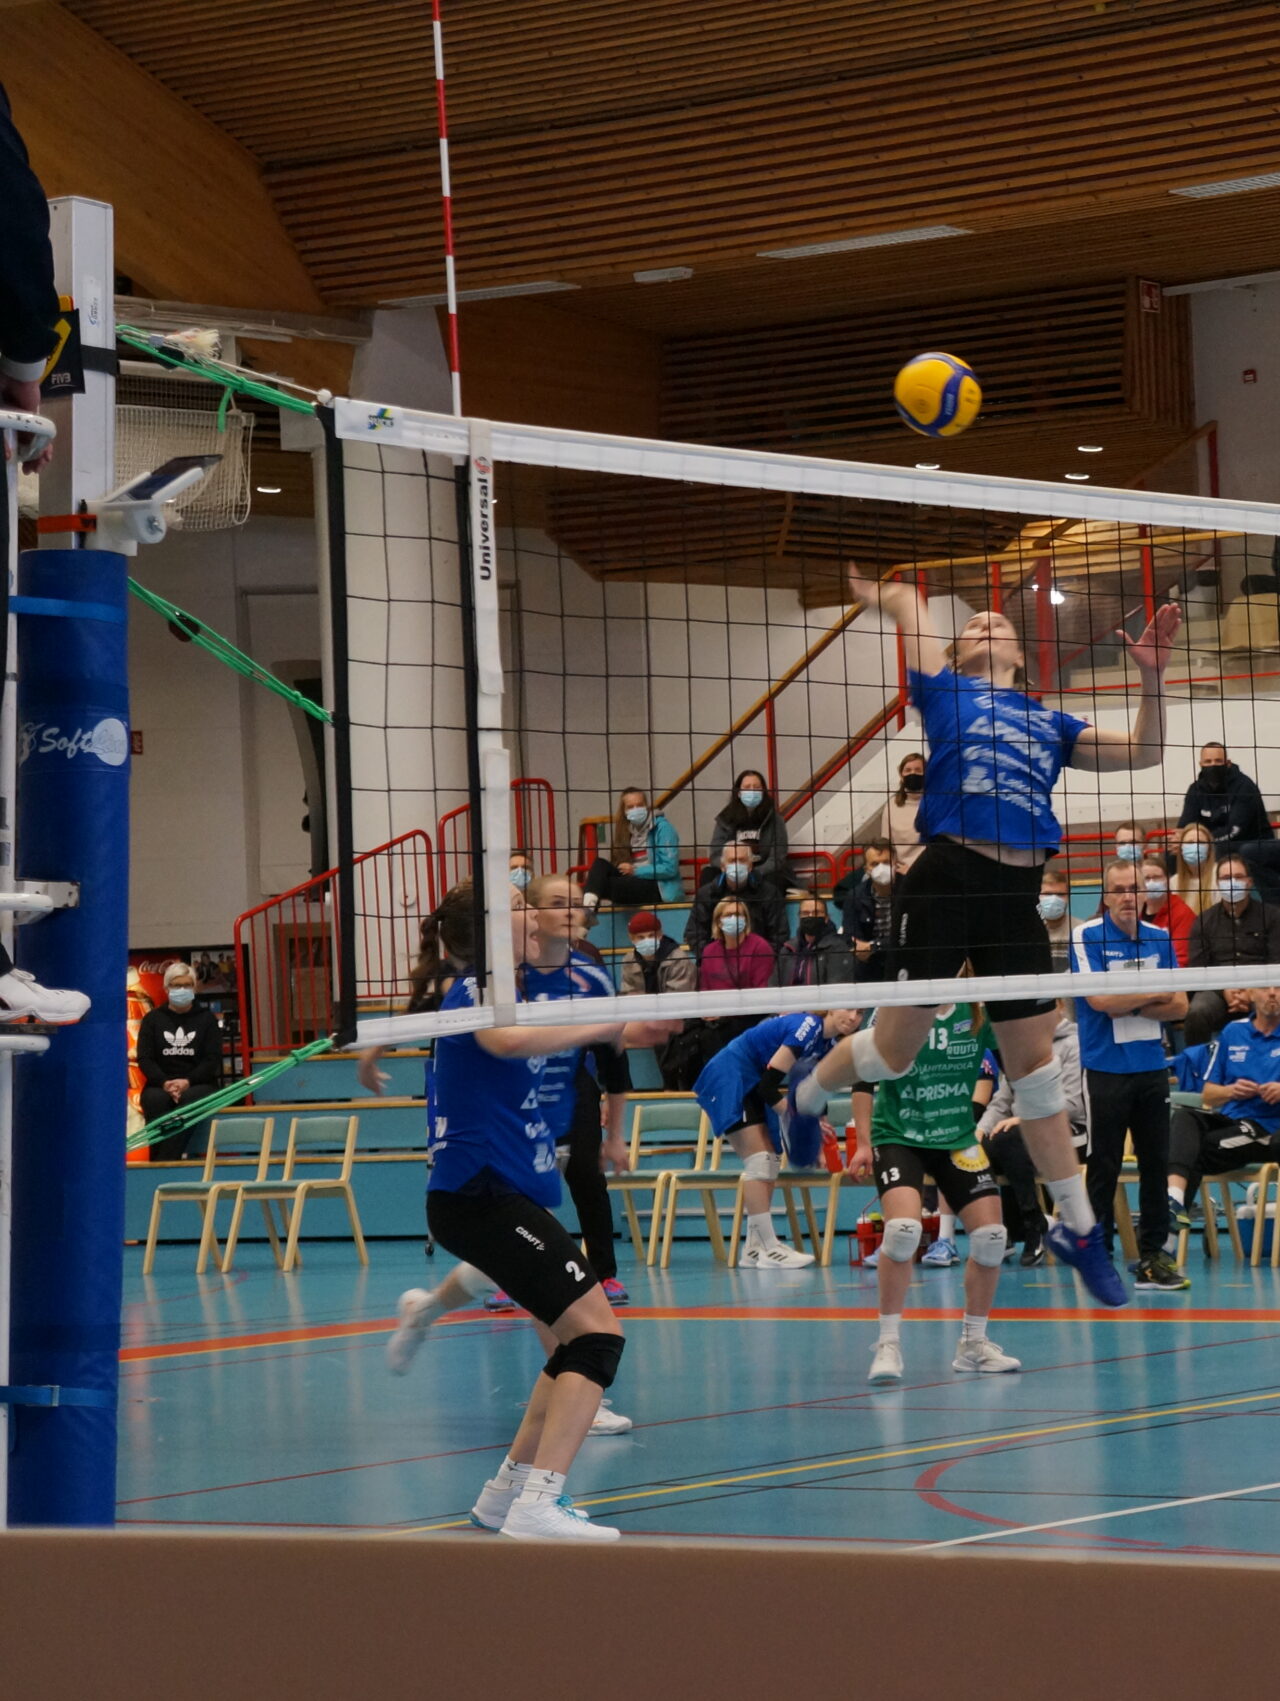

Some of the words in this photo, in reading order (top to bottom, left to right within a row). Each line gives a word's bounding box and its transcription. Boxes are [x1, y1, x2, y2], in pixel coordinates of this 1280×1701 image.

[477, 478, 492, 581] Universal
[928, 1027, 948, 1050] 13
[162, 1046, 195, 1056] adidas
[916, 1082, 969, 1102] PRISMA
[880, 1167, 900, 1185] 13
[514, 1226, 541, 1246] CRAFT
[565, 1260, 586, 1282] 2
